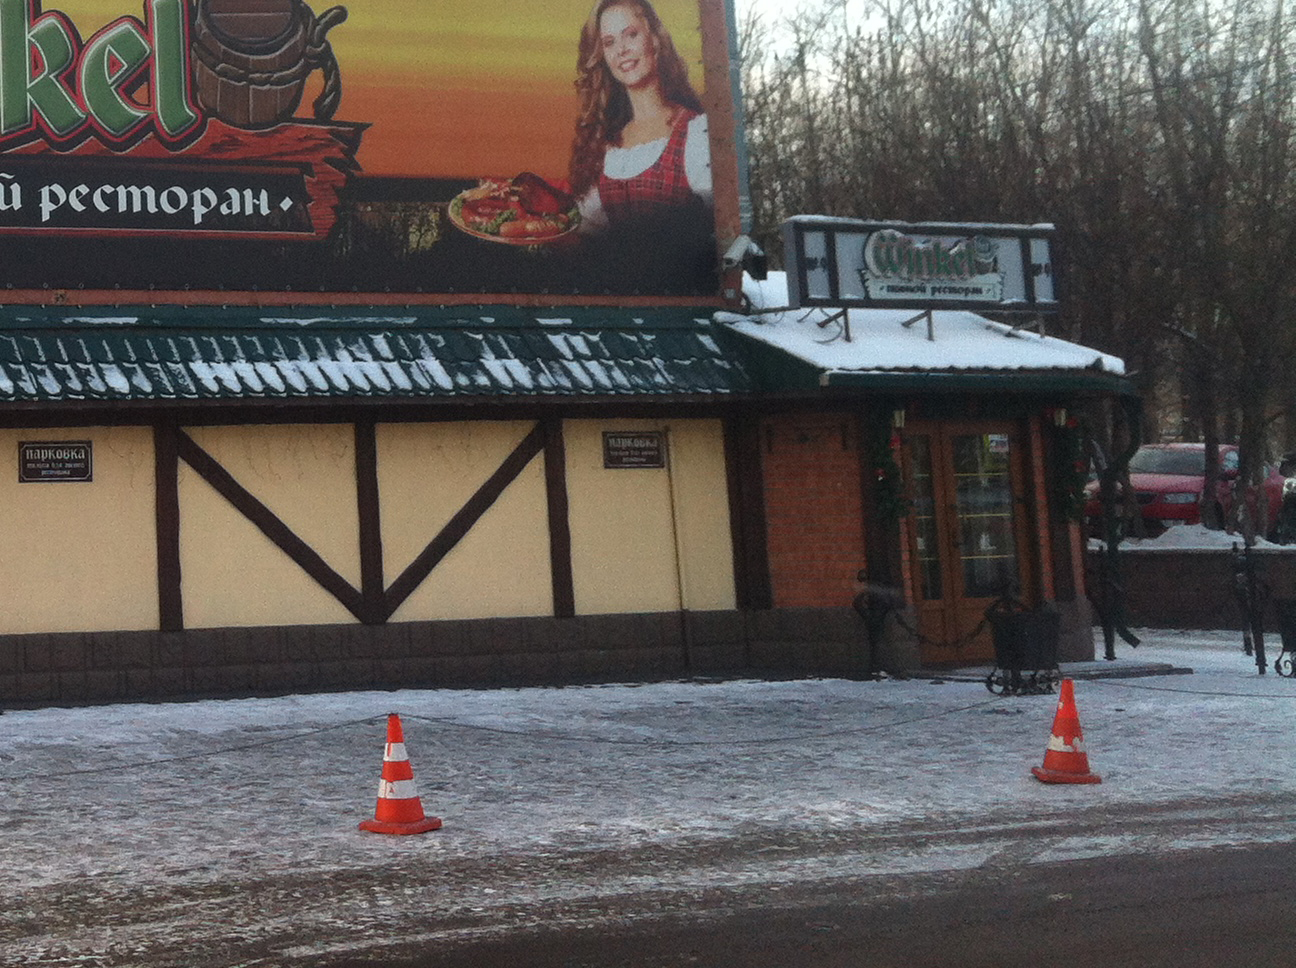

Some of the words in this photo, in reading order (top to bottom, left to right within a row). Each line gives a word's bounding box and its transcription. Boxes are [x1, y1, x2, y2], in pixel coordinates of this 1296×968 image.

[38, 183, 271, 225] ресторан
[871, 231, 977, 278] Winkel
[26, 449, 85, 460] парковка
